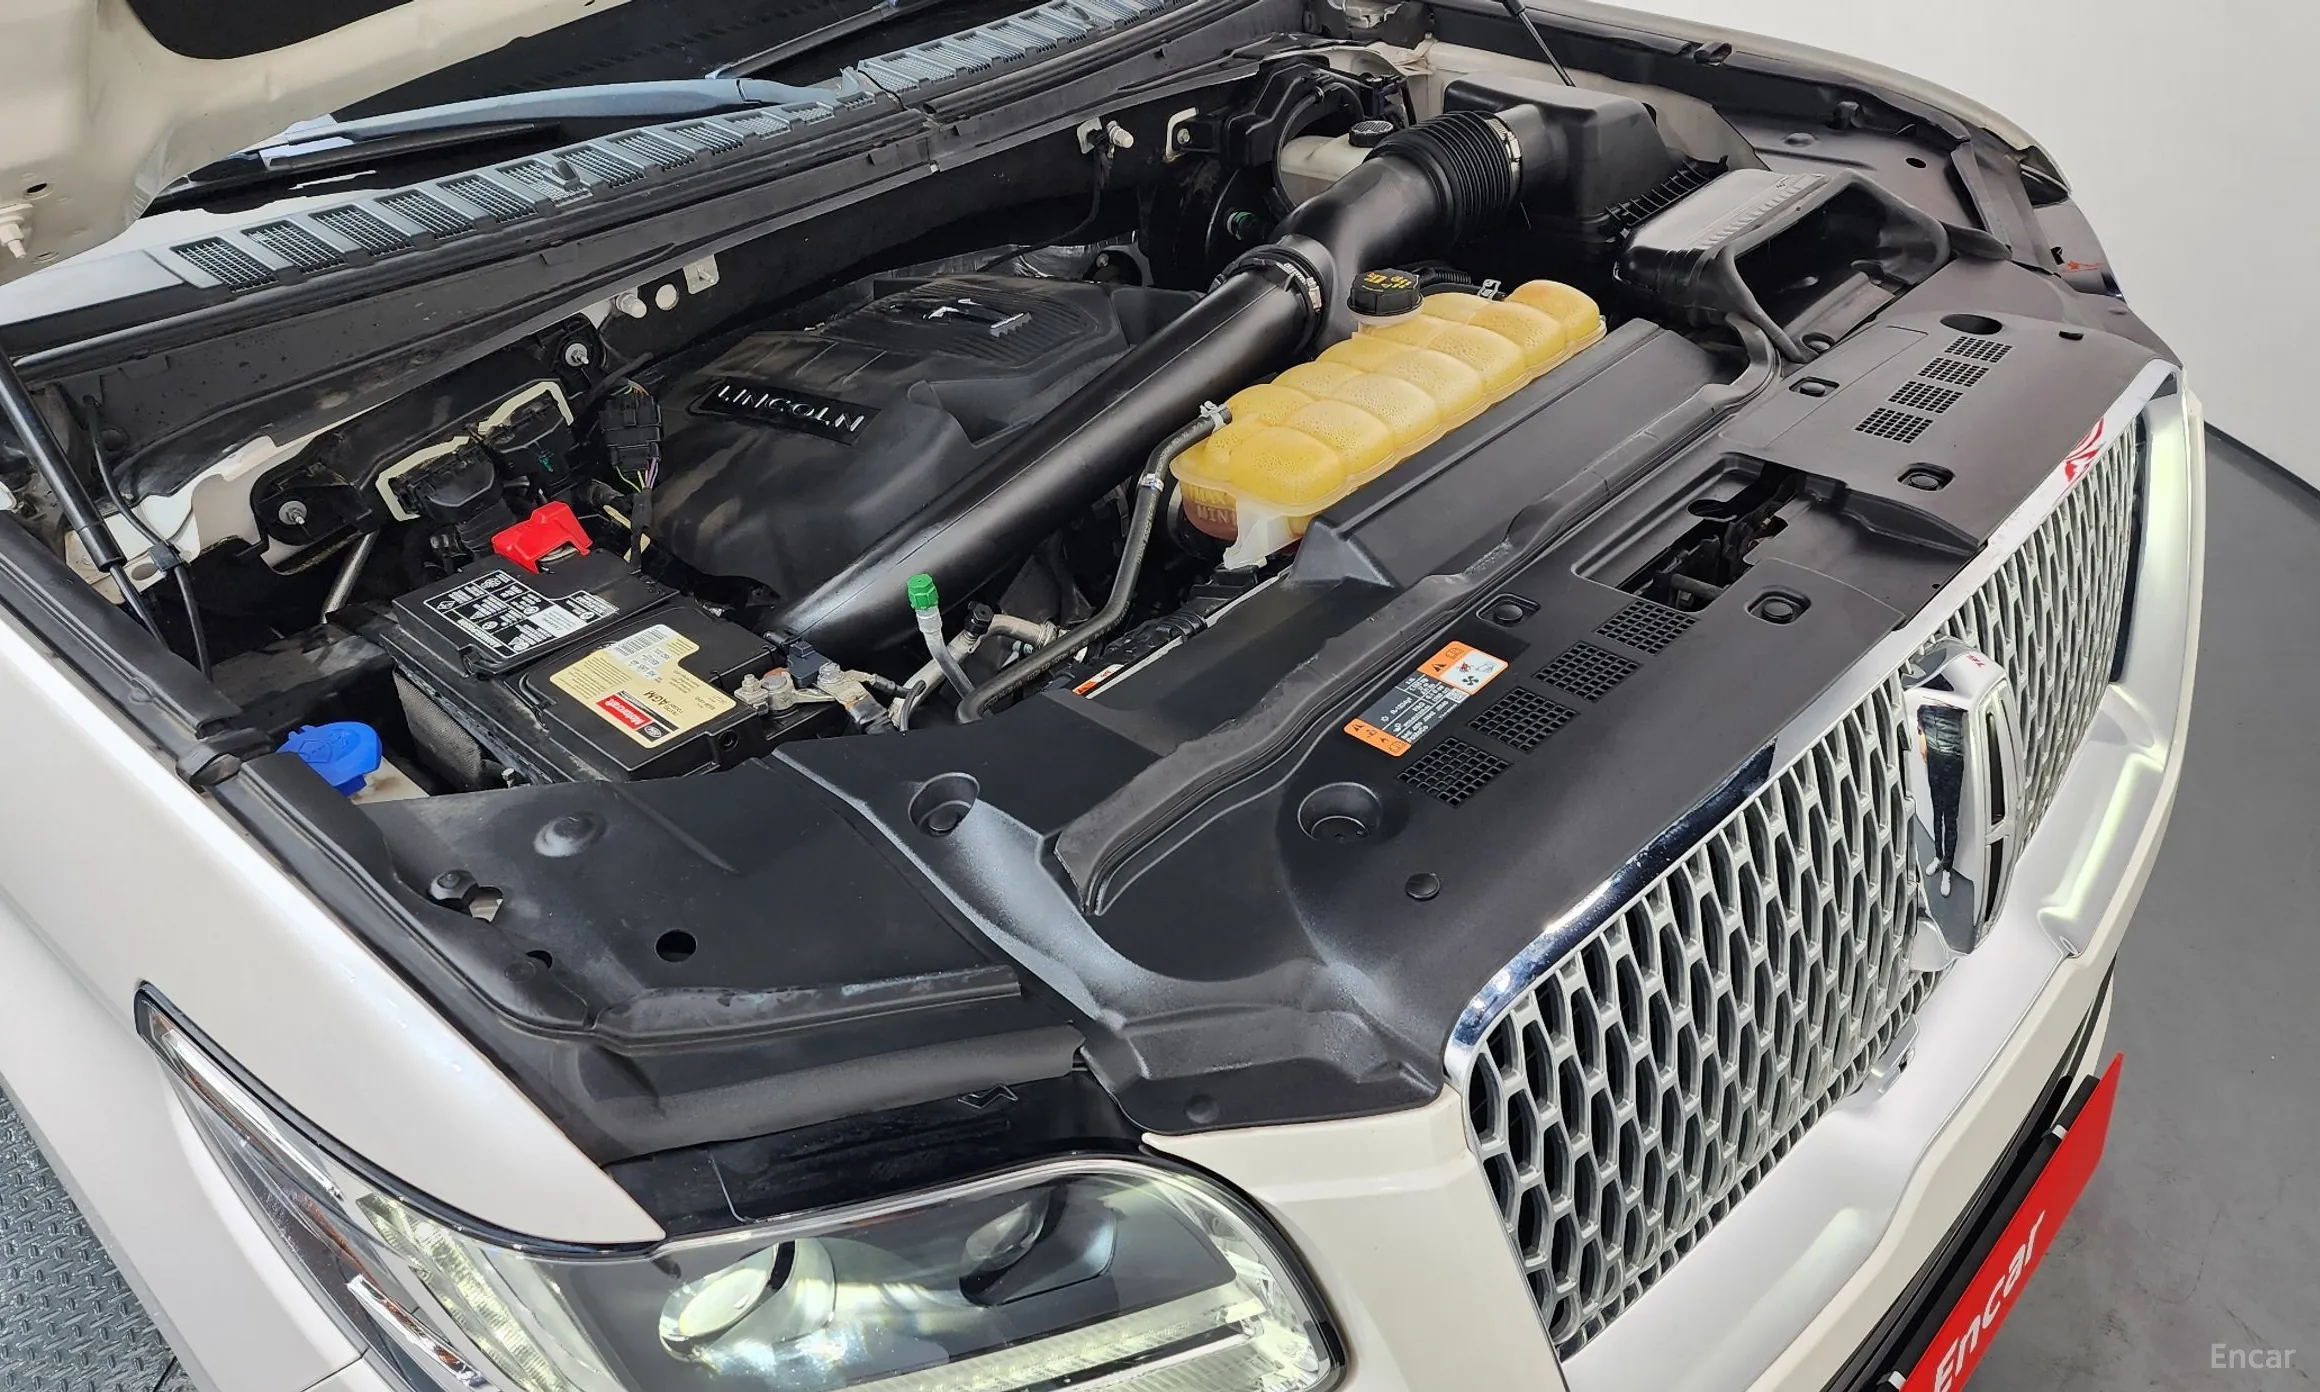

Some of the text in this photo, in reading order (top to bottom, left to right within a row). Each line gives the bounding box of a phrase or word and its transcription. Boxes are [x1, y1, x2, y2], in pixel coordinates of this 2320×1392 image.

[717, 384, 866, 432] LINCOLN
[1196, 504, 1230, 524] MIN
[604, 697, 645, 726] Motorcraft
[643, 690, 668, 707] AGM
[1933, 1210, 2045, 1392] Encar
